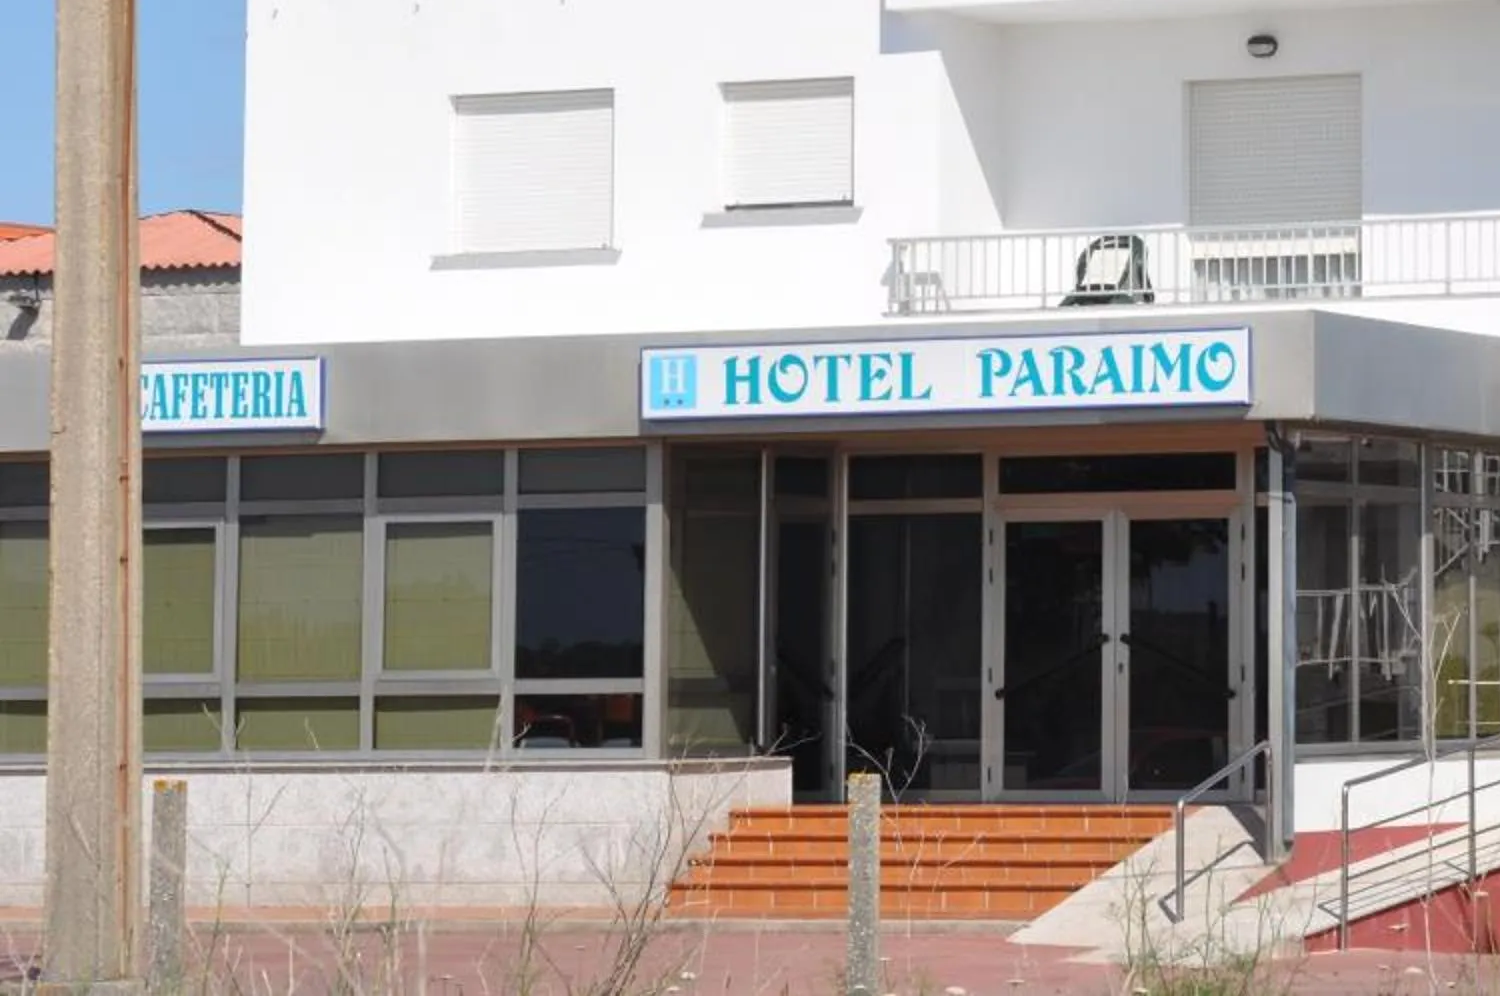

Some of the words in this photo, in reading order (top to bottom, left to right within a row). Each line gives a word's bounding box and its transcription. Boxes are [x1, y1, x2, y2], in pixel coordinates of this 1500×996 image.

[660, 358, 687, 395] H
[723, 351, 932, 405] HOTEL
[976, 342, 1236, 398] PARAIMO
